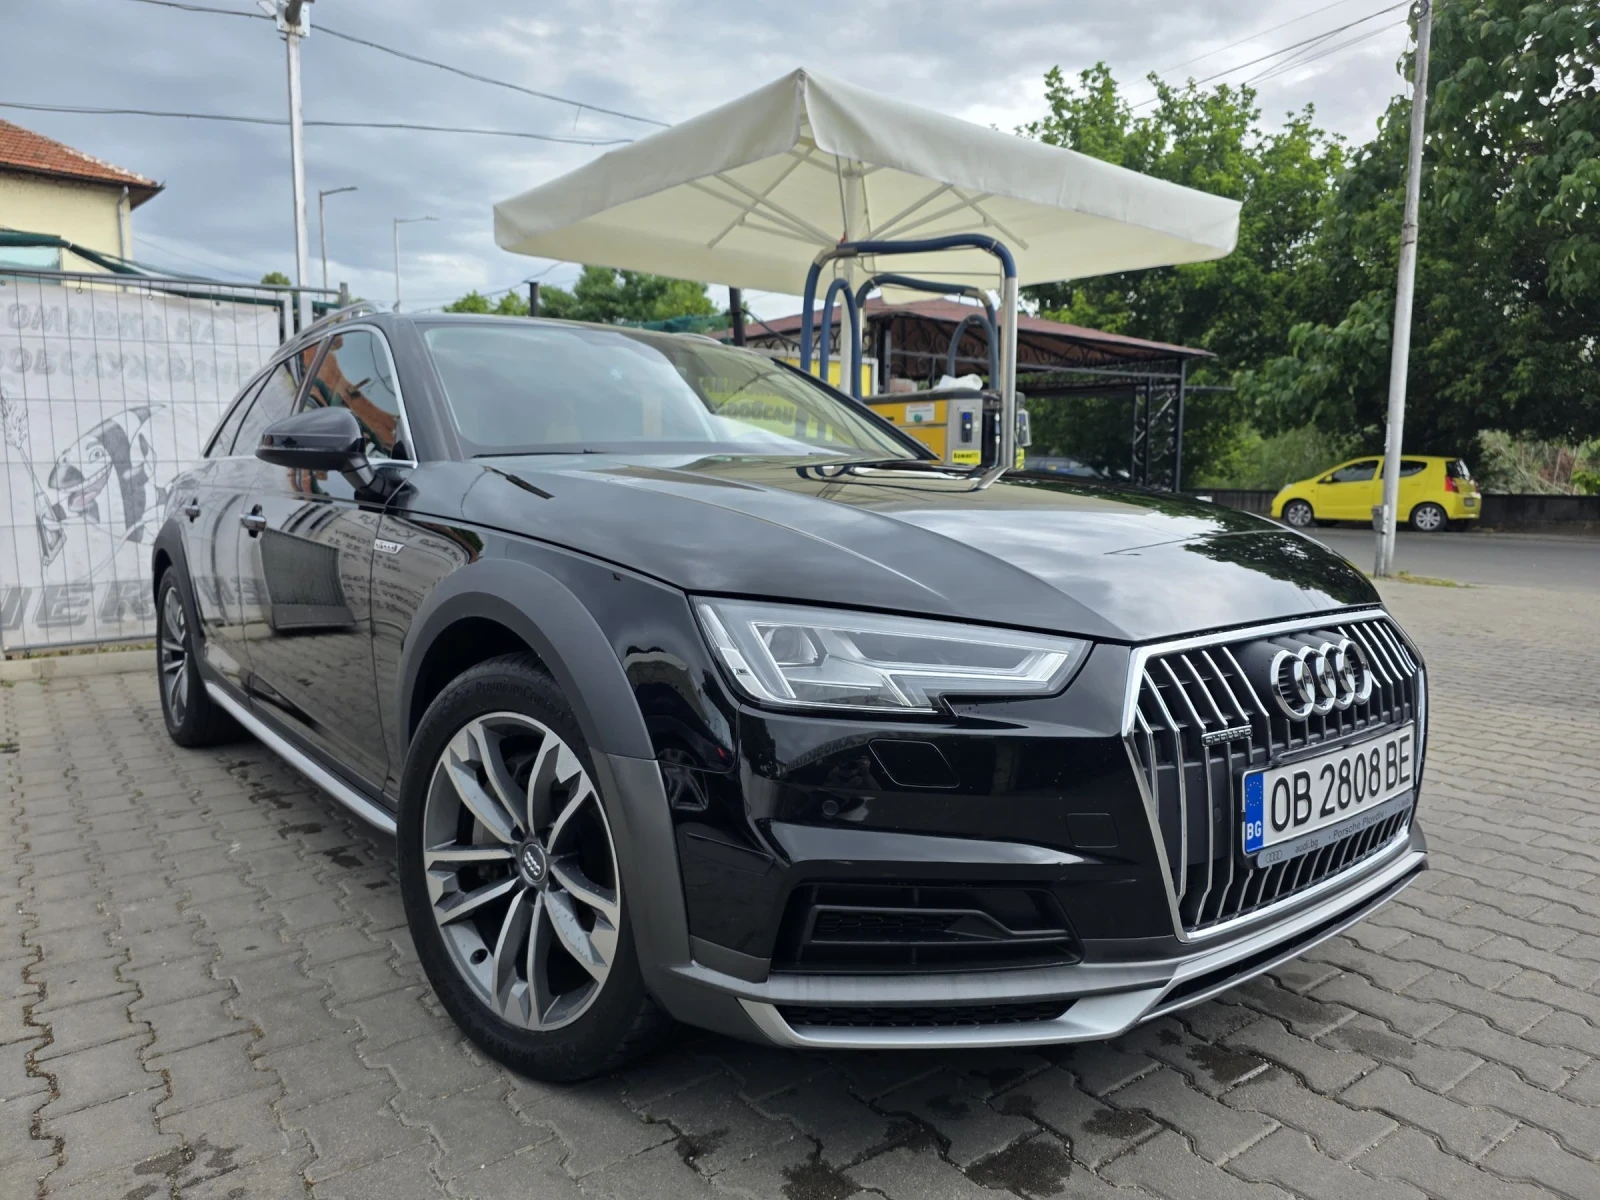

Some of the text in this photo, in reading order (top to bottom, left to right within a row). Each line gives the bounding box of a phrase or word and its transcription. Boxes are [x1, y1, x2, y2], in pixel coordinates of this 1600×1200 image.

[1205, 727, 1251, 744] quattro
[1271, 734, 1411, 832] OB 2808 BE
[1246, 821, 1262, 841] BG
[1295, 809, 1385, 854] audi.bg Porsche Plovdiv
